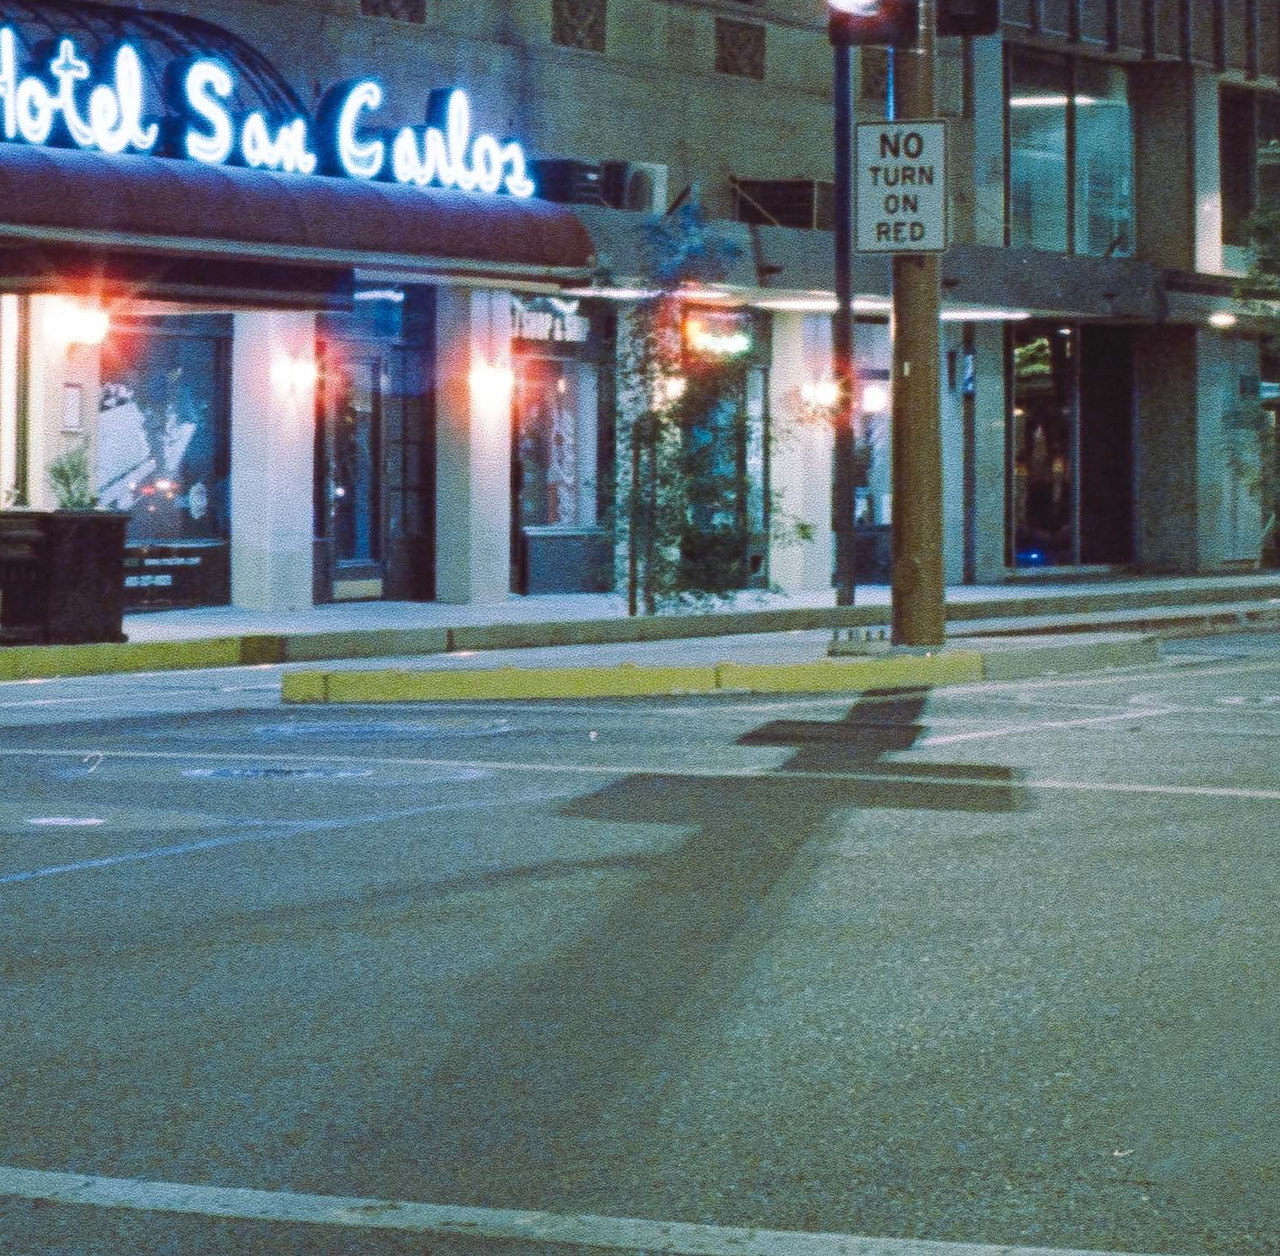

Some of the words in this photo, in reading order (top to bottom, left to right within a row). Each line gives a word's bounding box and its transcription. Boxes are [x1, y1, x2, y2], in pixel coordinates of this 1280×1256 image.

[184, 57, 317, 174] San
[338, 80, 535, 198] Carlos
[880, 131, 923, 158] NO
[868, 165, 934, 187] TURN
[883, 193, 918, 215] ON
[875, 222, 925, 242] RED
